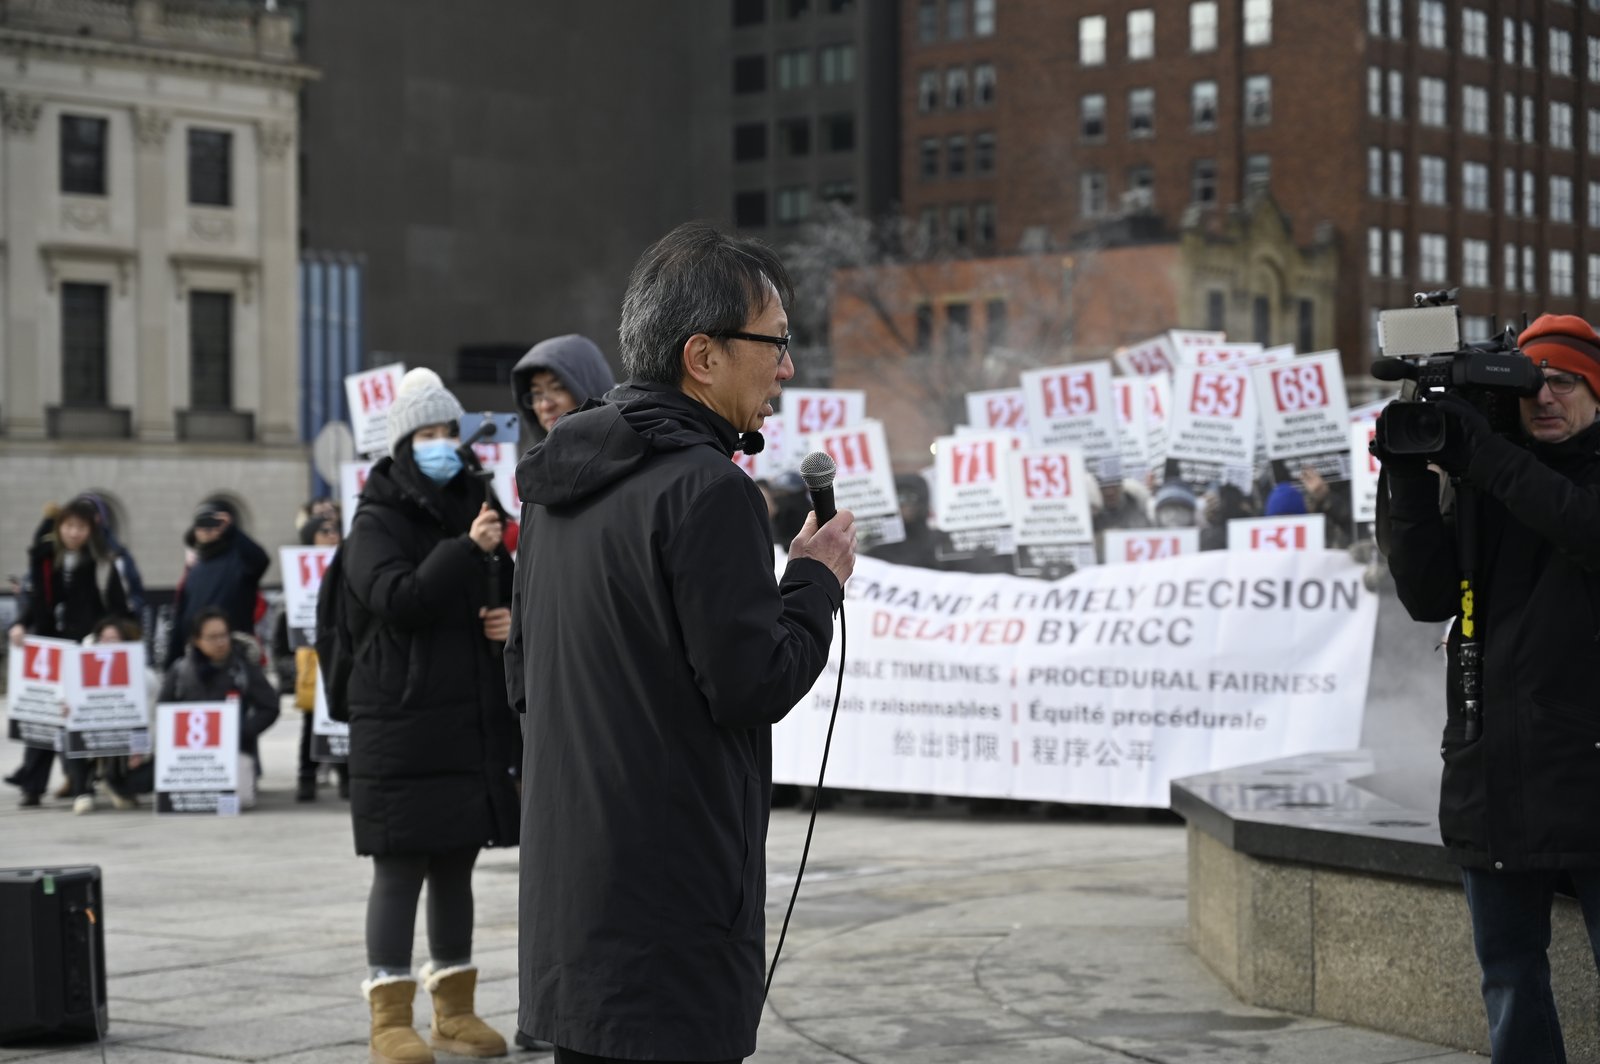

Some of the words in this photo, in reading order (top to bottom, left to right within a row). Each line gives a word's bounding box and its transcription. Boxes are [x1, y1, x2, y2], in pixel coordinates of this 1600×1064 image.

[1045, 373, 1094, 416] 15
[1193, 373, 1242, 416] 53
[1274, 364, 1327, 410] 68
[800, 397, 844, 433] 42
[956, 443, 995, 484] 71
[1024, 456, 1069, 498] 53
[846, 575, 971, 616] EMAND
[1153, 578, 1360, 612] DECISION
[871, 612, 1026, 645] DELAYED
[1037, 619, 1090, 645] BY
[1096, 618, 1194, 647] IRCC
[891, 660, 1000, 685] TIMELINES
[1028, 667, 1200, 692] PROCEDURAL
[1208, 671, 1337, 694] FAIRNESS
[869, 696, 1001, 720] raisonnables
[1029, 698, 1104, 726] Équité
[1111, 704, 1267, 731] procédurale
[1032, 737, 1155, 771] 程序公平
